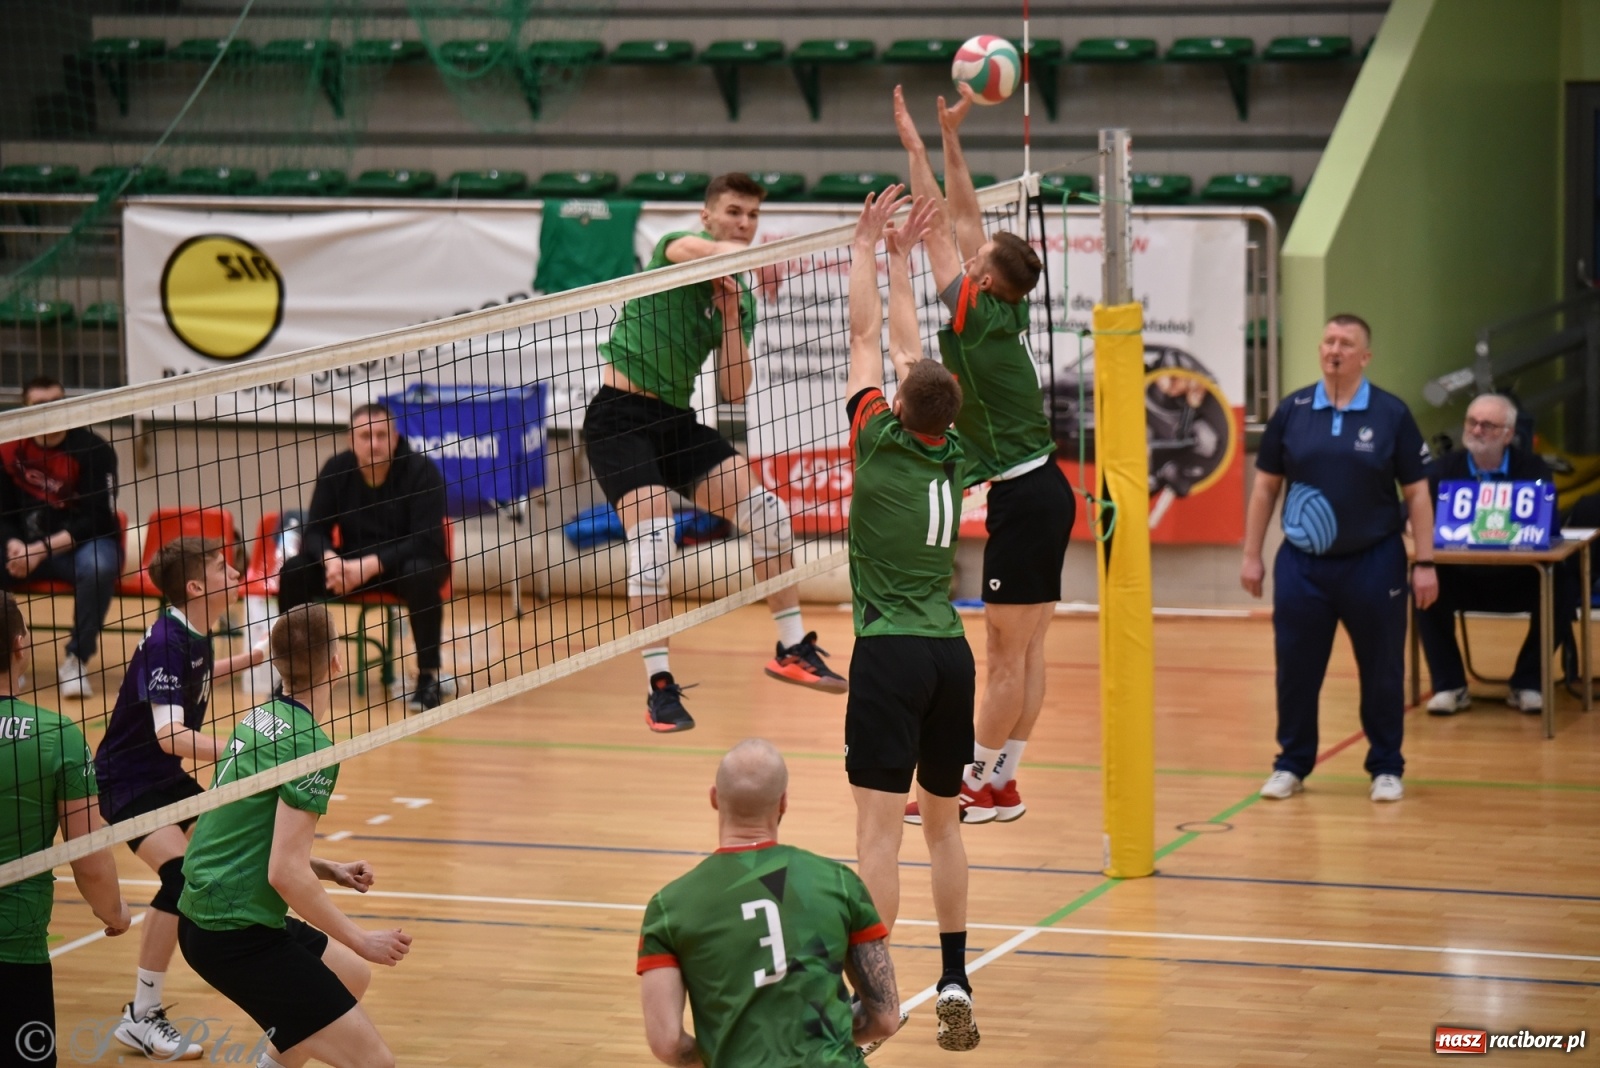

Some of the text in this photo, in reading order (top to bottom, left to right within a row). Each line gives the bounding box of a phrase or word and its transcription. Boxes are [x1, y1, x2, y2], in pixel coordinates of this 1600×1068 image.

[925, 478, 954, 548] 11
[1453, 487, 1473, 519] 6
[1515, 487, 1535, 519] 6
[741, 899, 787, 988] 3
